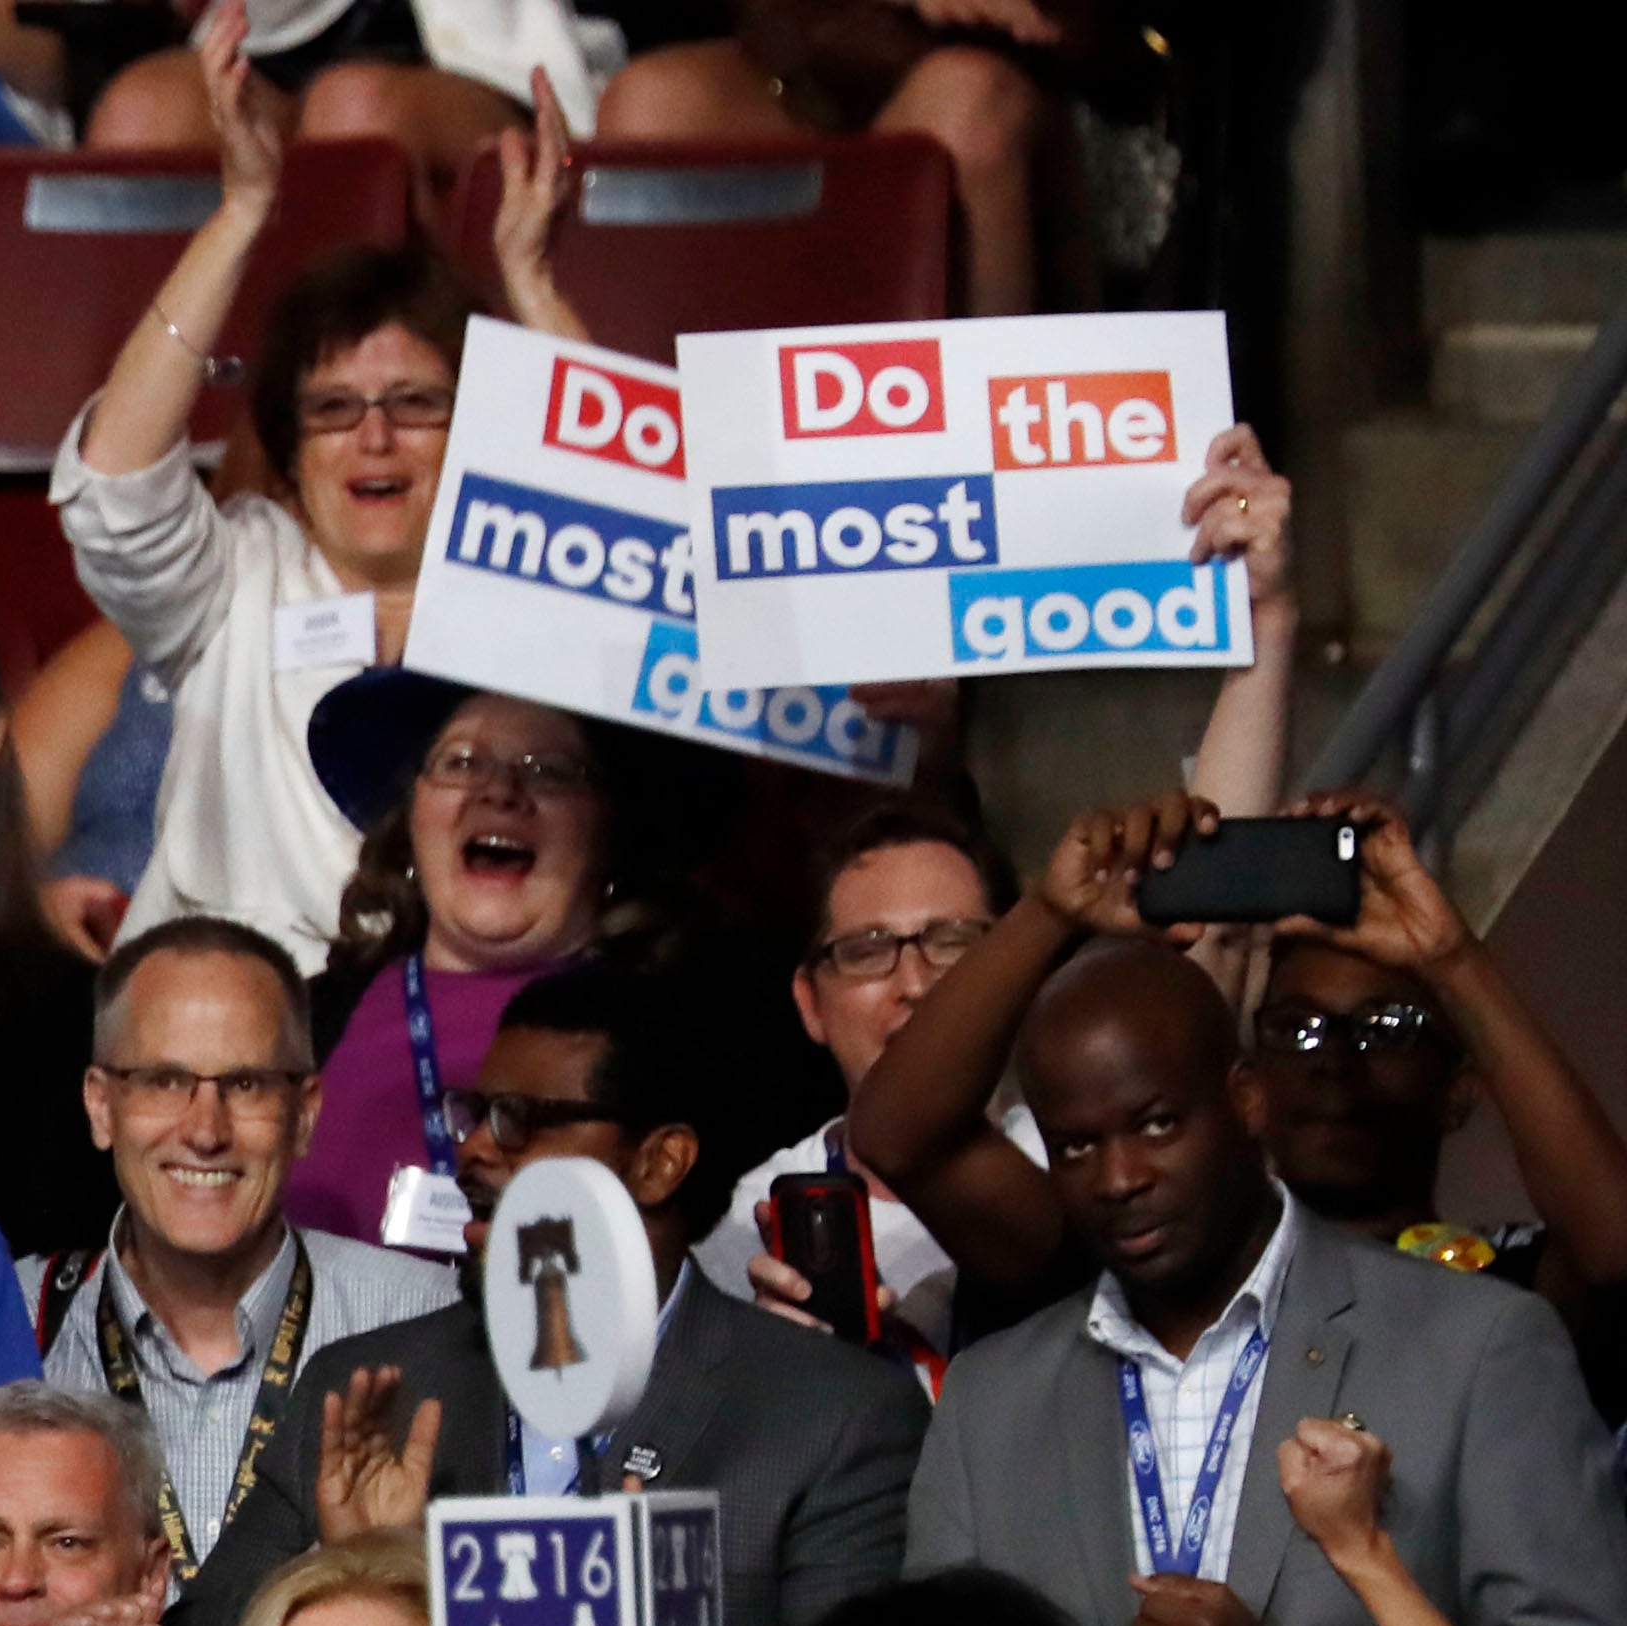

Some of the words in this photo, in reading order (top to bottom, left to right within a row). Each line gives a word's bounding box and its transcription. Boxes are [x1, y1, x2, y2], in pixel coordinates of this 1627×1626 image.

[556, 367, 681, 467] Do
[792, 351, 930, 433] Do
[997, 383, 1168, 465] the
[460, 496, 695, 611] most
[725, 481, 987, 575] most
[962, 564, 1220, 661] good
